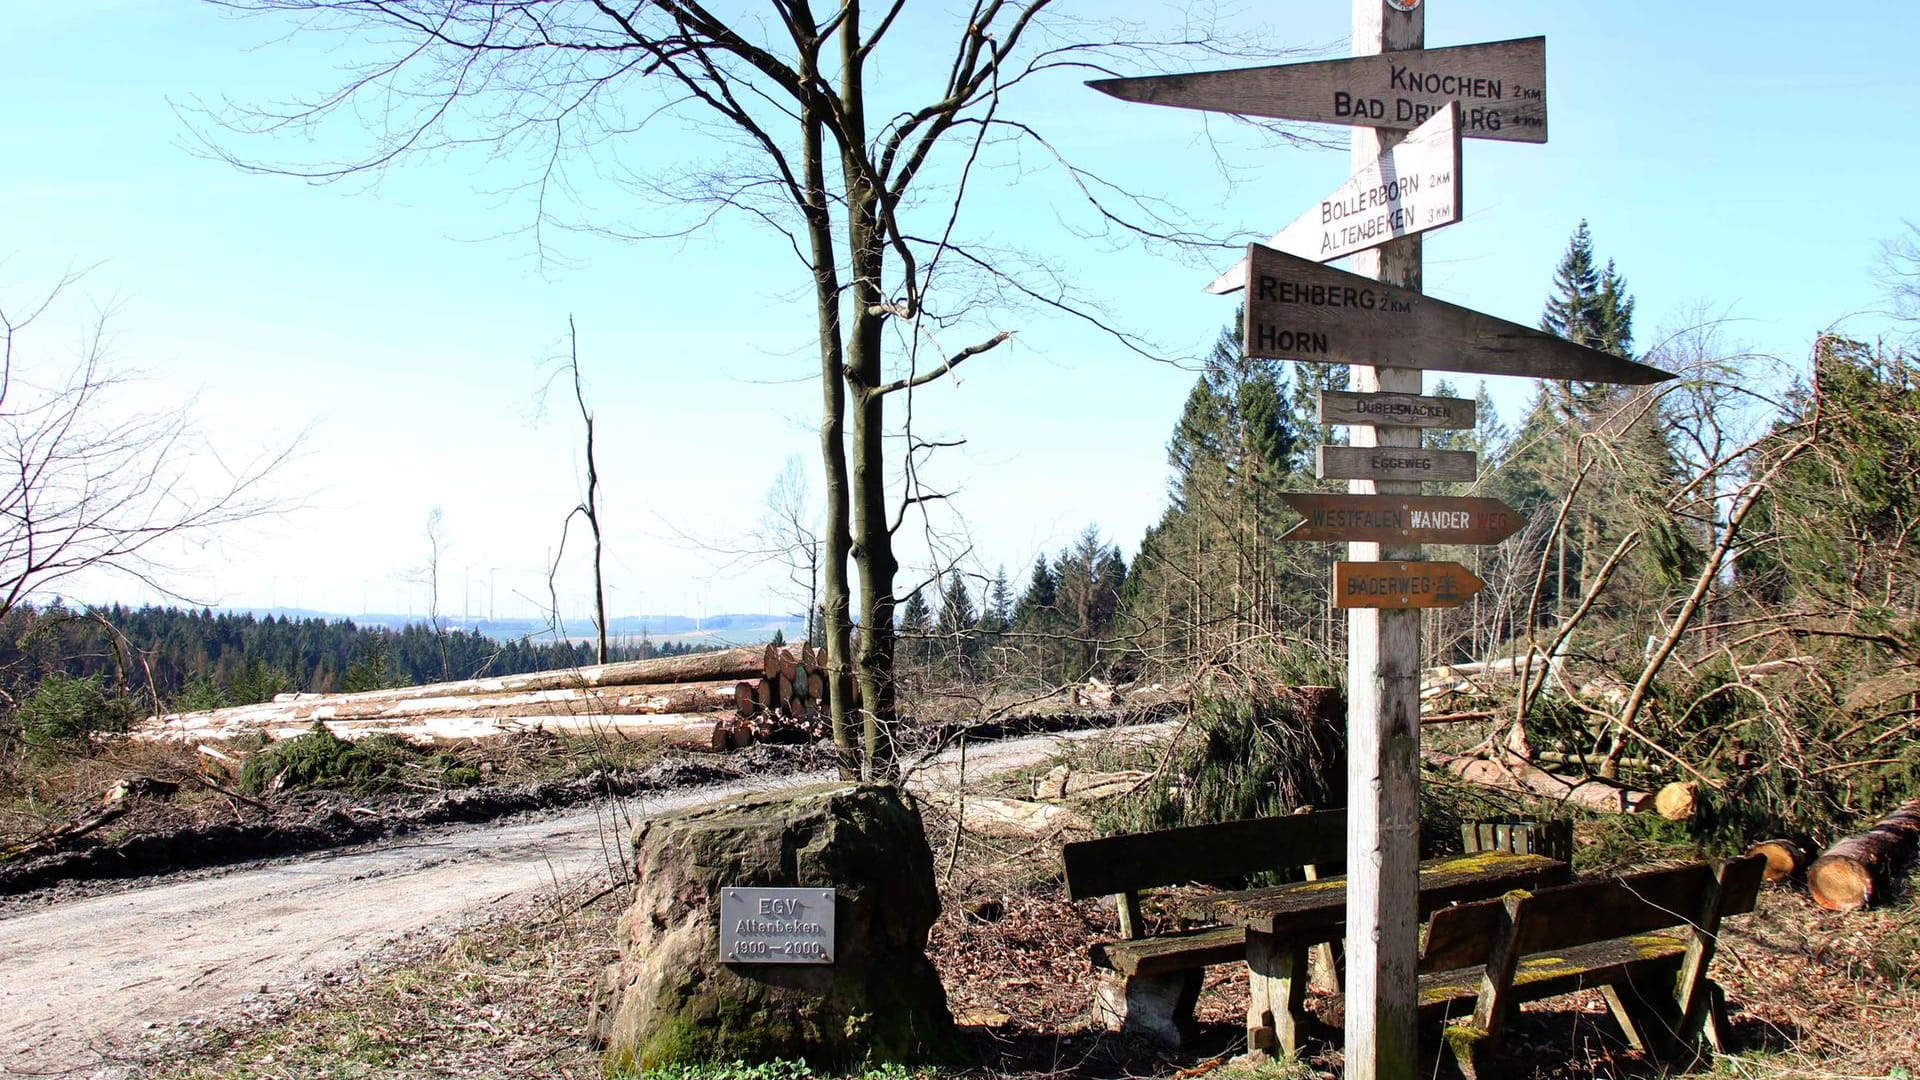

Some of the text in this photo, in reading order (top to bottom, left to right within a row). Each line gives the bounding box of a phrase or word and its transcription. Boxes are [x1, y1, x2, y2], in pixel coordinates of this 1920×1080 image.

[1391, 66, 1501, 99] KNOCHEN
[1334, 92, 1384, 119] BAD
[1396, 98, 1501, 130] DRRG
[1322, 174, 1419, 224] BOLLERBORN
[1320, 205, 1414, 254] ALTENBEKEN
[1258, 275, 1375, 310] REHBERG
[1257, 323, 1327, 353] HORN
[1371, 455, 1431, 469] EGGEWEG
[1312, 509, 1507, 530] WESTFALEN WANDER WEG
[759, 898, 798, 915] EGV
[735, 919, 819, 933] Altenbeken
